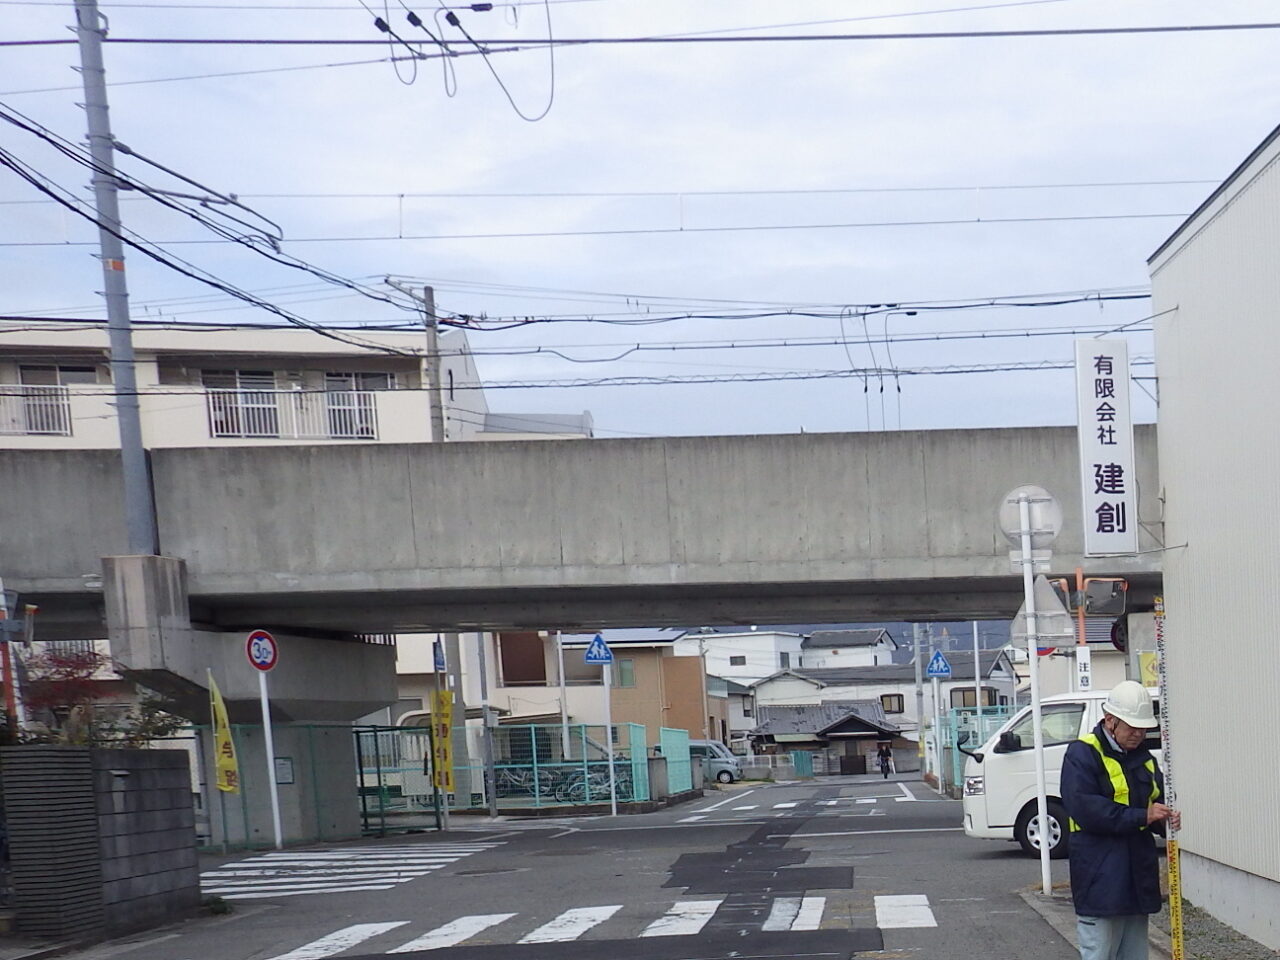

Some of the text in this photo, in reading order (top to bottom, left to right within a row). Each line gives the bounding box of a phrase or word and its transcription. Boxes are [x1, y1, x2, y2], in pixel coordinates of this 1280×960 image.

[1093, 355, 1127, 533] 有限会社 建創
[1079, 662, 1089, 686] 注意
